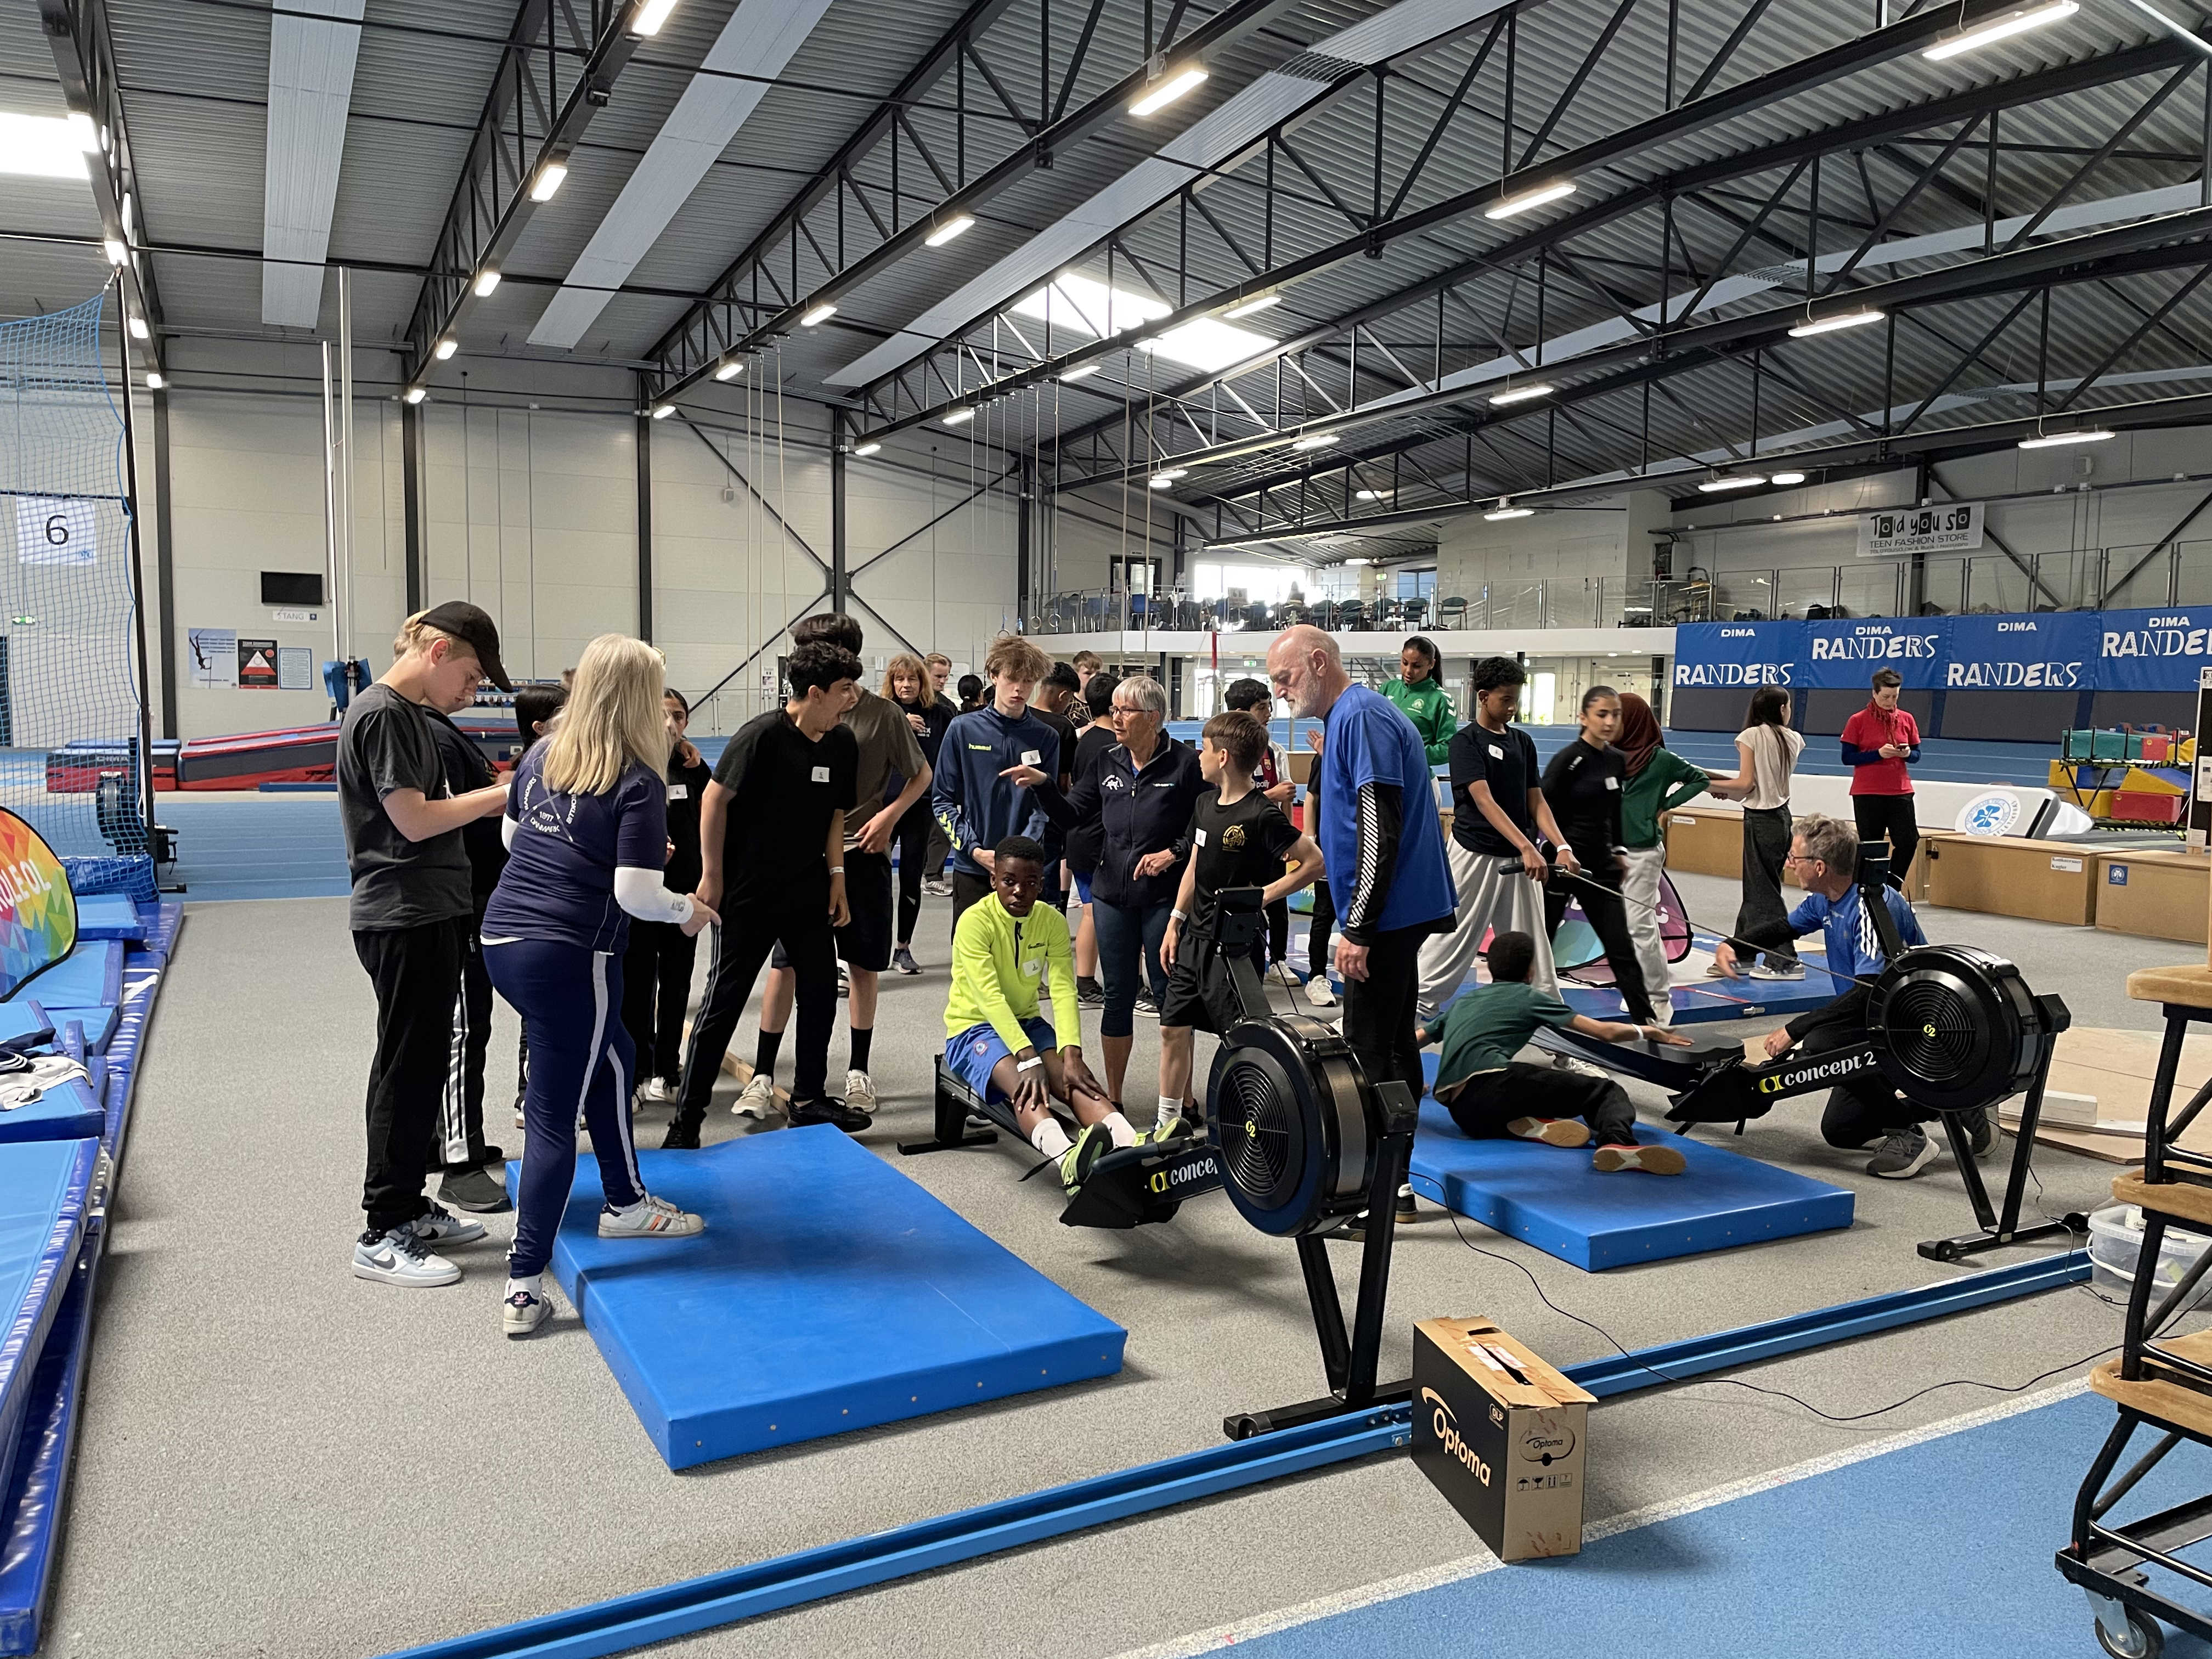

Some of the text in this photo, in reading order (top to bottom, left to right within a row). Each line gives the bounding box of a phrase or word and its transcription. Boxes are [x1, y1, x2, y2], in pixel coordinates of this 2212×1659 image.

[46, 515, 69, 545] 6
[1870, 515, 1904, 538] Told
[1910, 511, 1940, 535] you
[1870, 533, 1969, 549] TEEN FASHION STORE
[1855, 625, 1893, 635] DIMA
[1997, 622, 2037, 632] DIMA
[2148, 616, 2190, 628] DIMA
[1720, 628, 1756, 637] DIMA
[1812, 635, 1939, 659] RANDERS
[1675, 663, 1794, 686] RANDERS
[1947, 662, 2082, 687] RANDERS
[530, 817, 560, 833] DANMARK
[1923, 1024, 1936, 1037] C2
[1784, 1051, 1877, 1086] concept 2
[1245, 1120, 1256, 1138] C2
[1434, 1408, 1491, 1487] Optoma
[1533, 1438, 1563, 1449] Optoma
